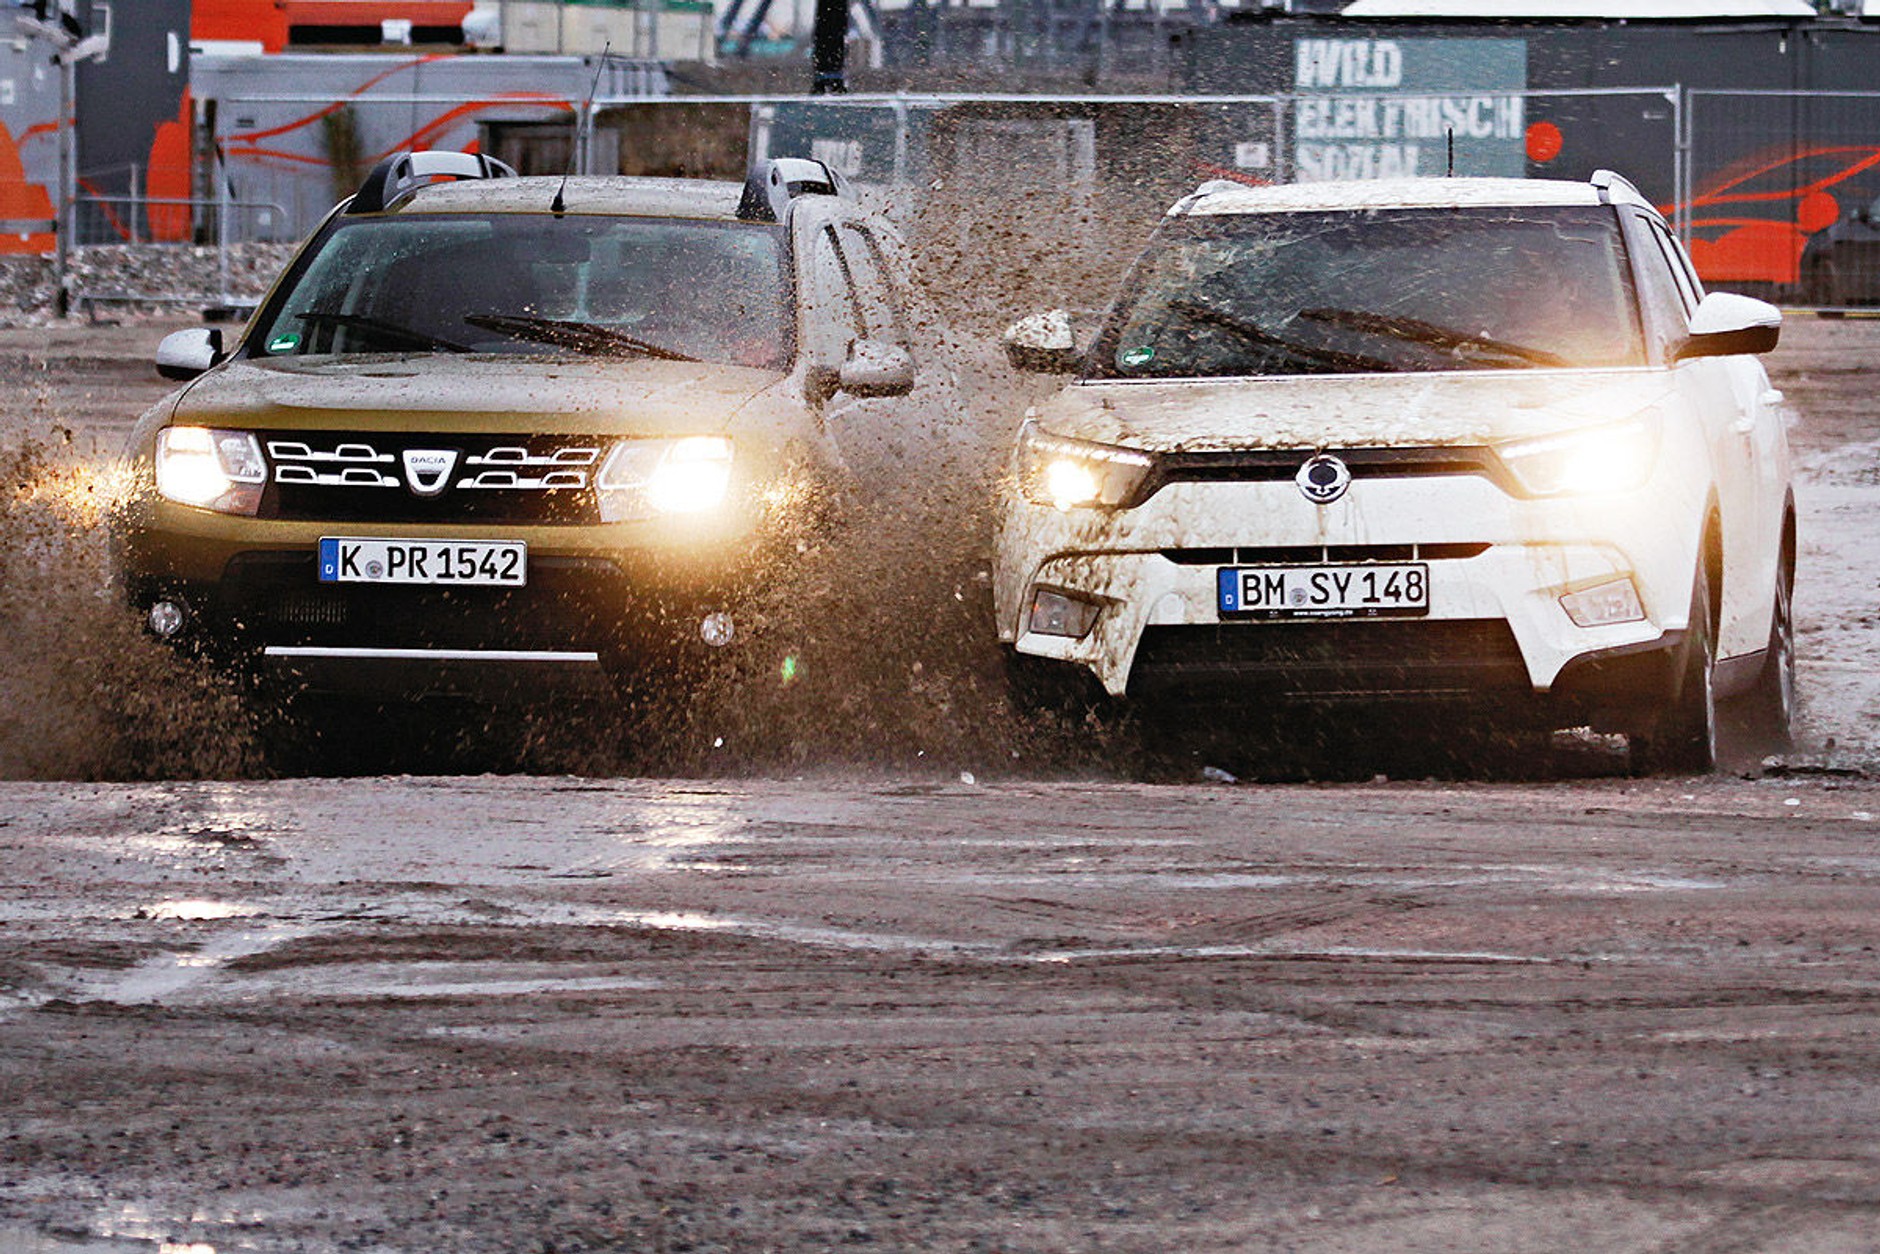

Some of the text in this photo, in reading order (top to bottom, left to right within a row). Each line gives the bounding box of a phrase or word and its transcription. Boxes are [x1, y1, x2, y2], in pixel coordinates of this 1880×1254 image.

[1297, 40, 1402, 87] WILD
[1297, 96, 1523, 139] ELEKTRISCH
[411, 456, 446, 464] DACIA
[341, 545, 362, 577] K
[1242, 573, 1285, 606] BM
[1362, 570, 1423, 603] 148
